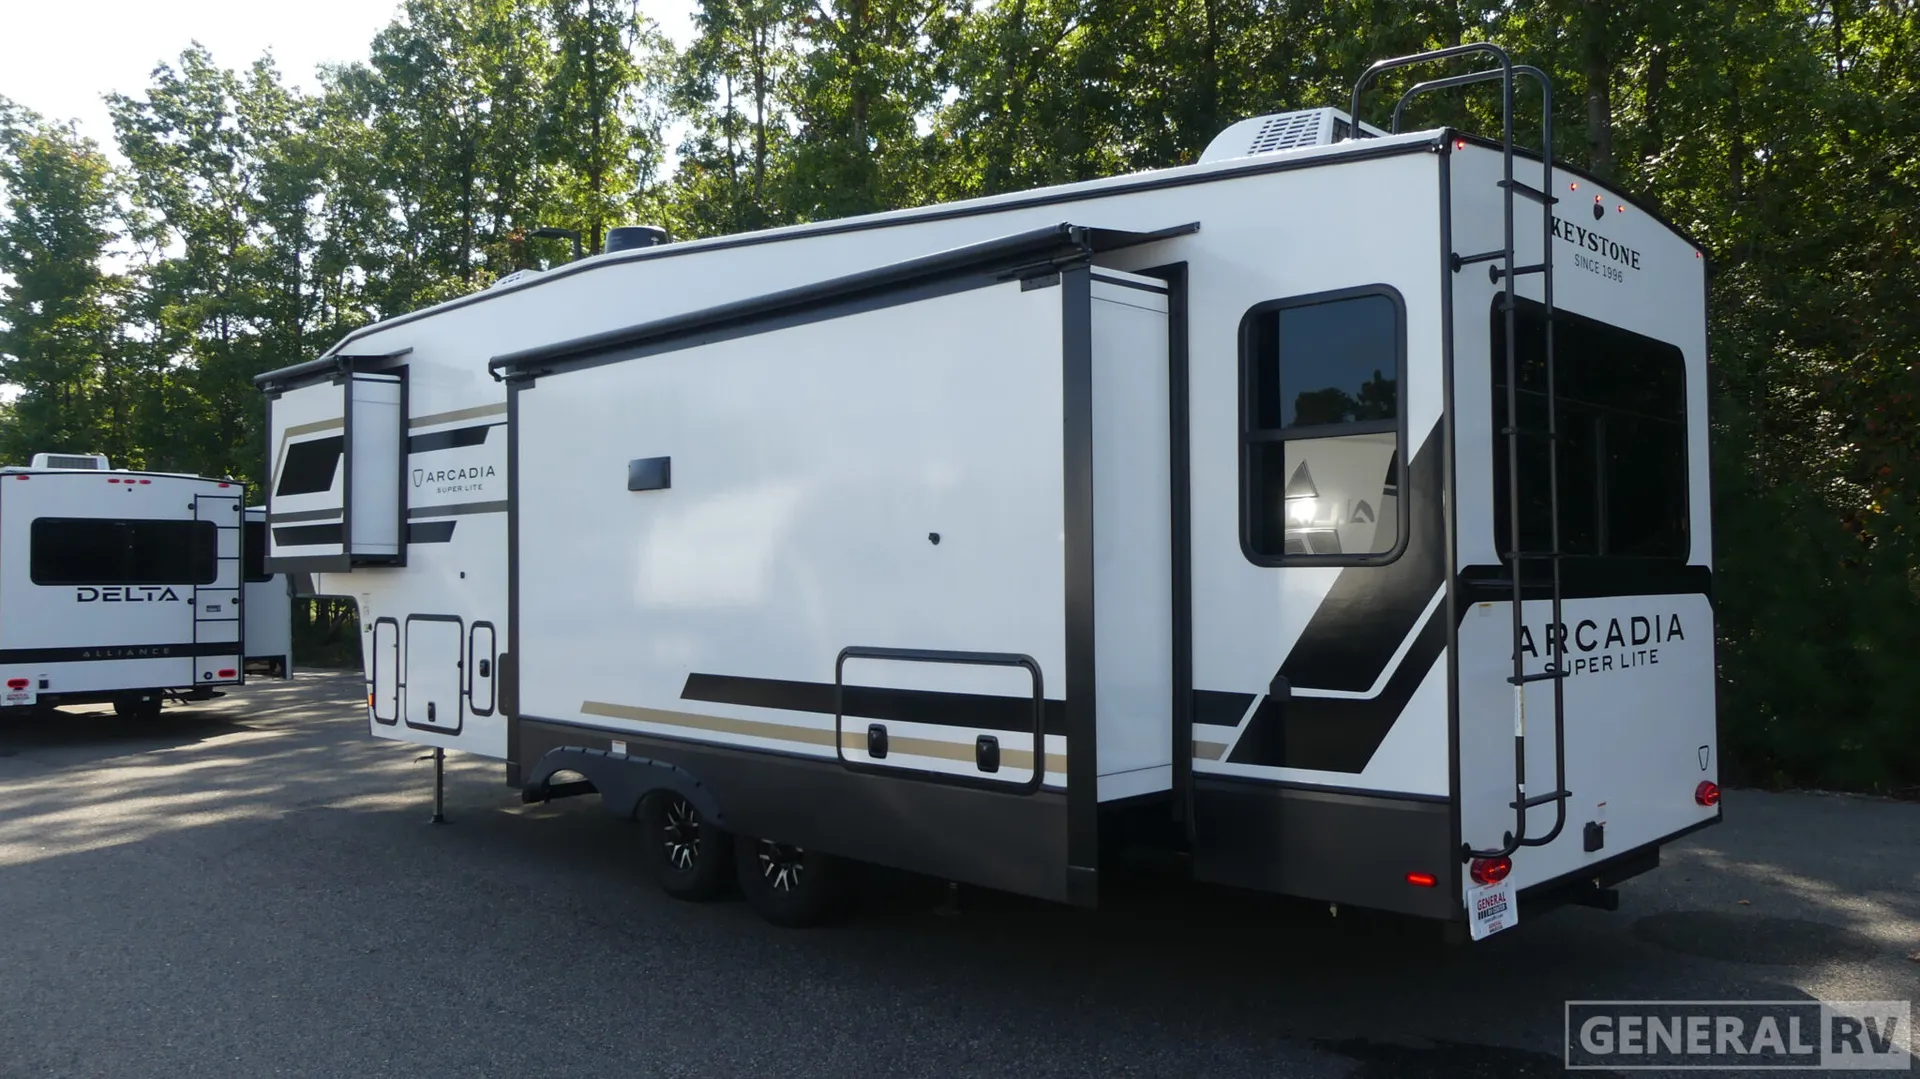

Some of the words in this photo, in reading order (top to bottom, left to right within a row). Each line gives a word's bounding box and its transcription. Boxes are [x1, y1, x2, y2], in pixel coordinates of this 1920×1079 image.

[1550, 215, 1641, 270] KEYSTONE
[1574, 253, 1600, 275] SINCE
[1602, 264, 1624, 283] 1996
[426, 465, 496, 483] ARCADIA
[436, 485, 462, 494] SUPER
[465, 483, 484, 492] LITE
[77, 587, 179, 602] DELTA
[1511, 613, 1685, 660] ARCADIA
[83, 648, 170, 658] ALLIANCE
[1620, 649, 1659, 669] LITE
[1477, 892, 1507, 911] GENERAL
